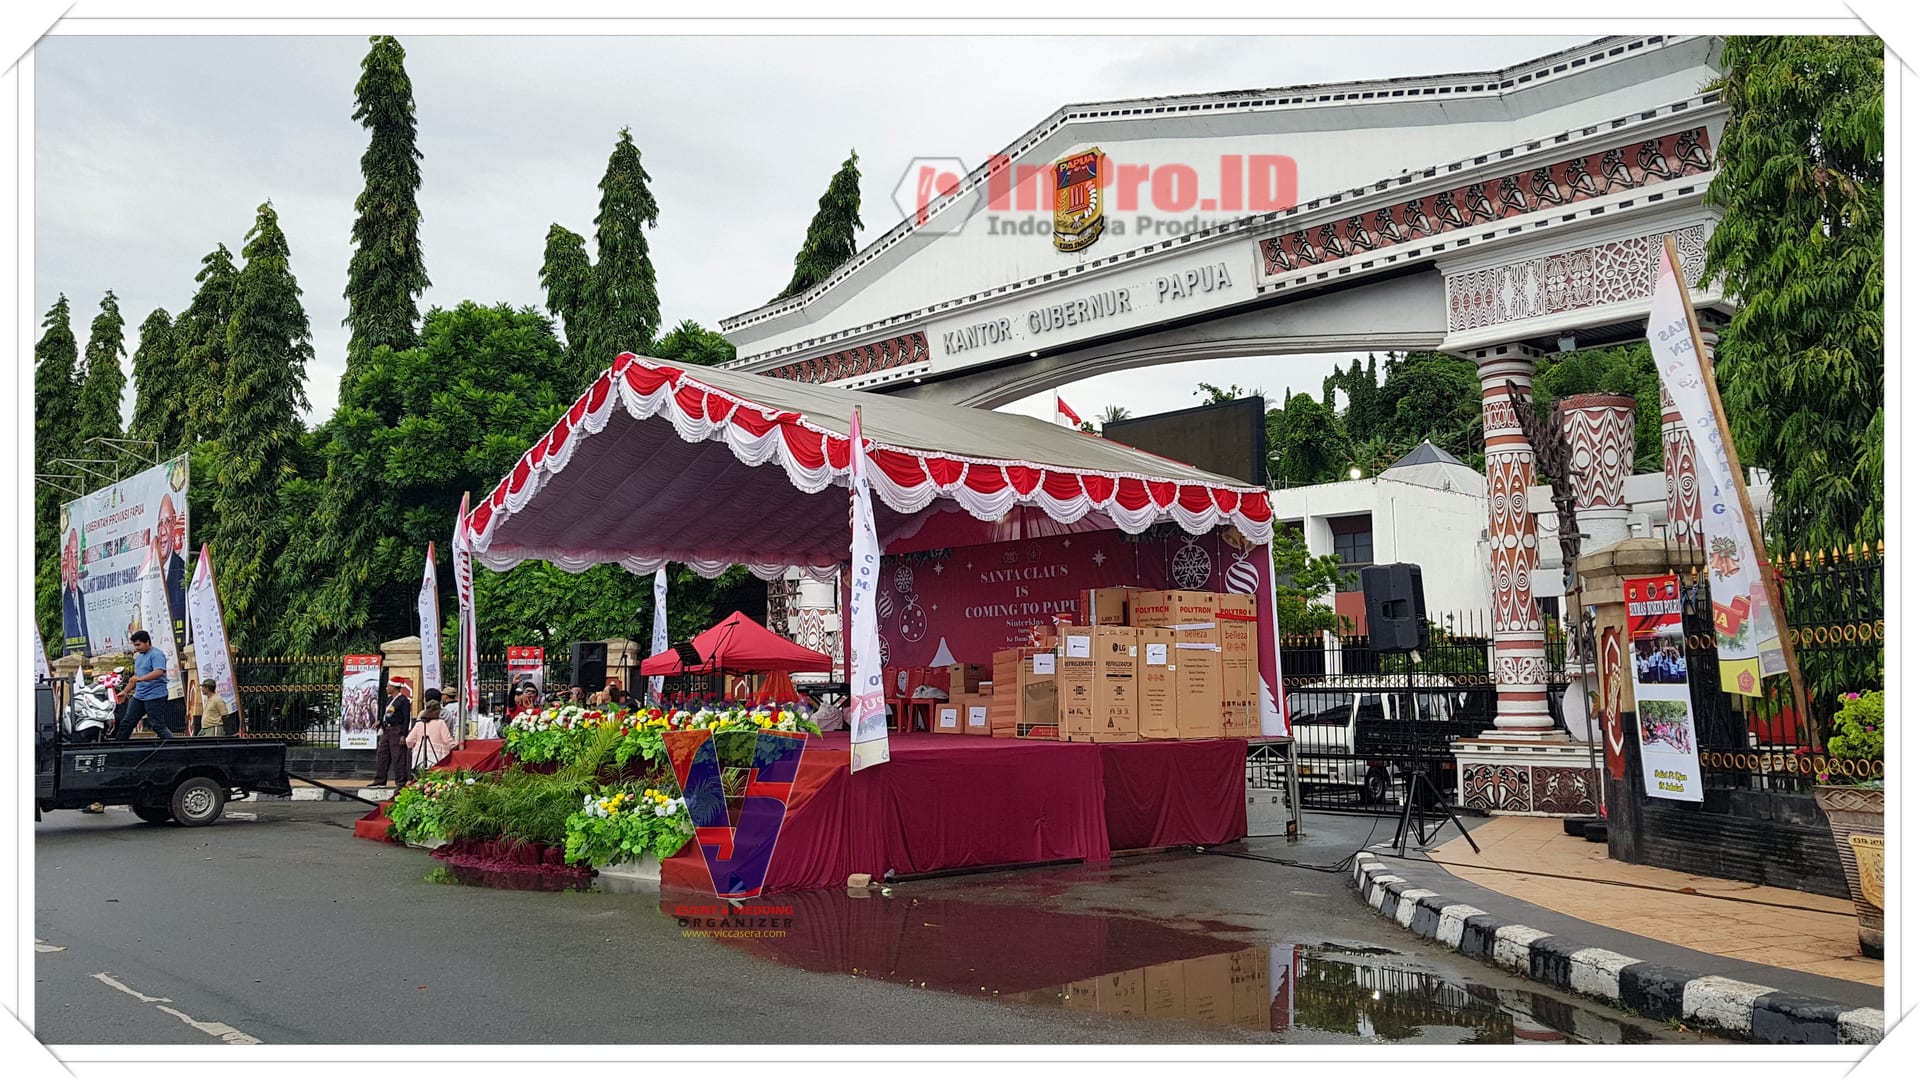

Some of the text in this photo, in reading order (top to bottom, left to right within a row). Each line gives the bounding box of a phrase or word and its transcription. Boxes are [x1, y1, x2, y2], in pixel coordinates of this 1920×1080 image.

[1060, 154, 1095, 173] PAPUA
[943, 262, 1233, 355] KANTOR GUBERNUR PAPUA
[980, 564, 1069, 583] SANTA CLAUS
[1015, 585, 1029, 598] IS
[965, 599, 1081, 619] COMING TO PAPU
[1135, 605, 1170, 614] POLYTRON
[1180, 606, 1212, 614] POLYTRON
